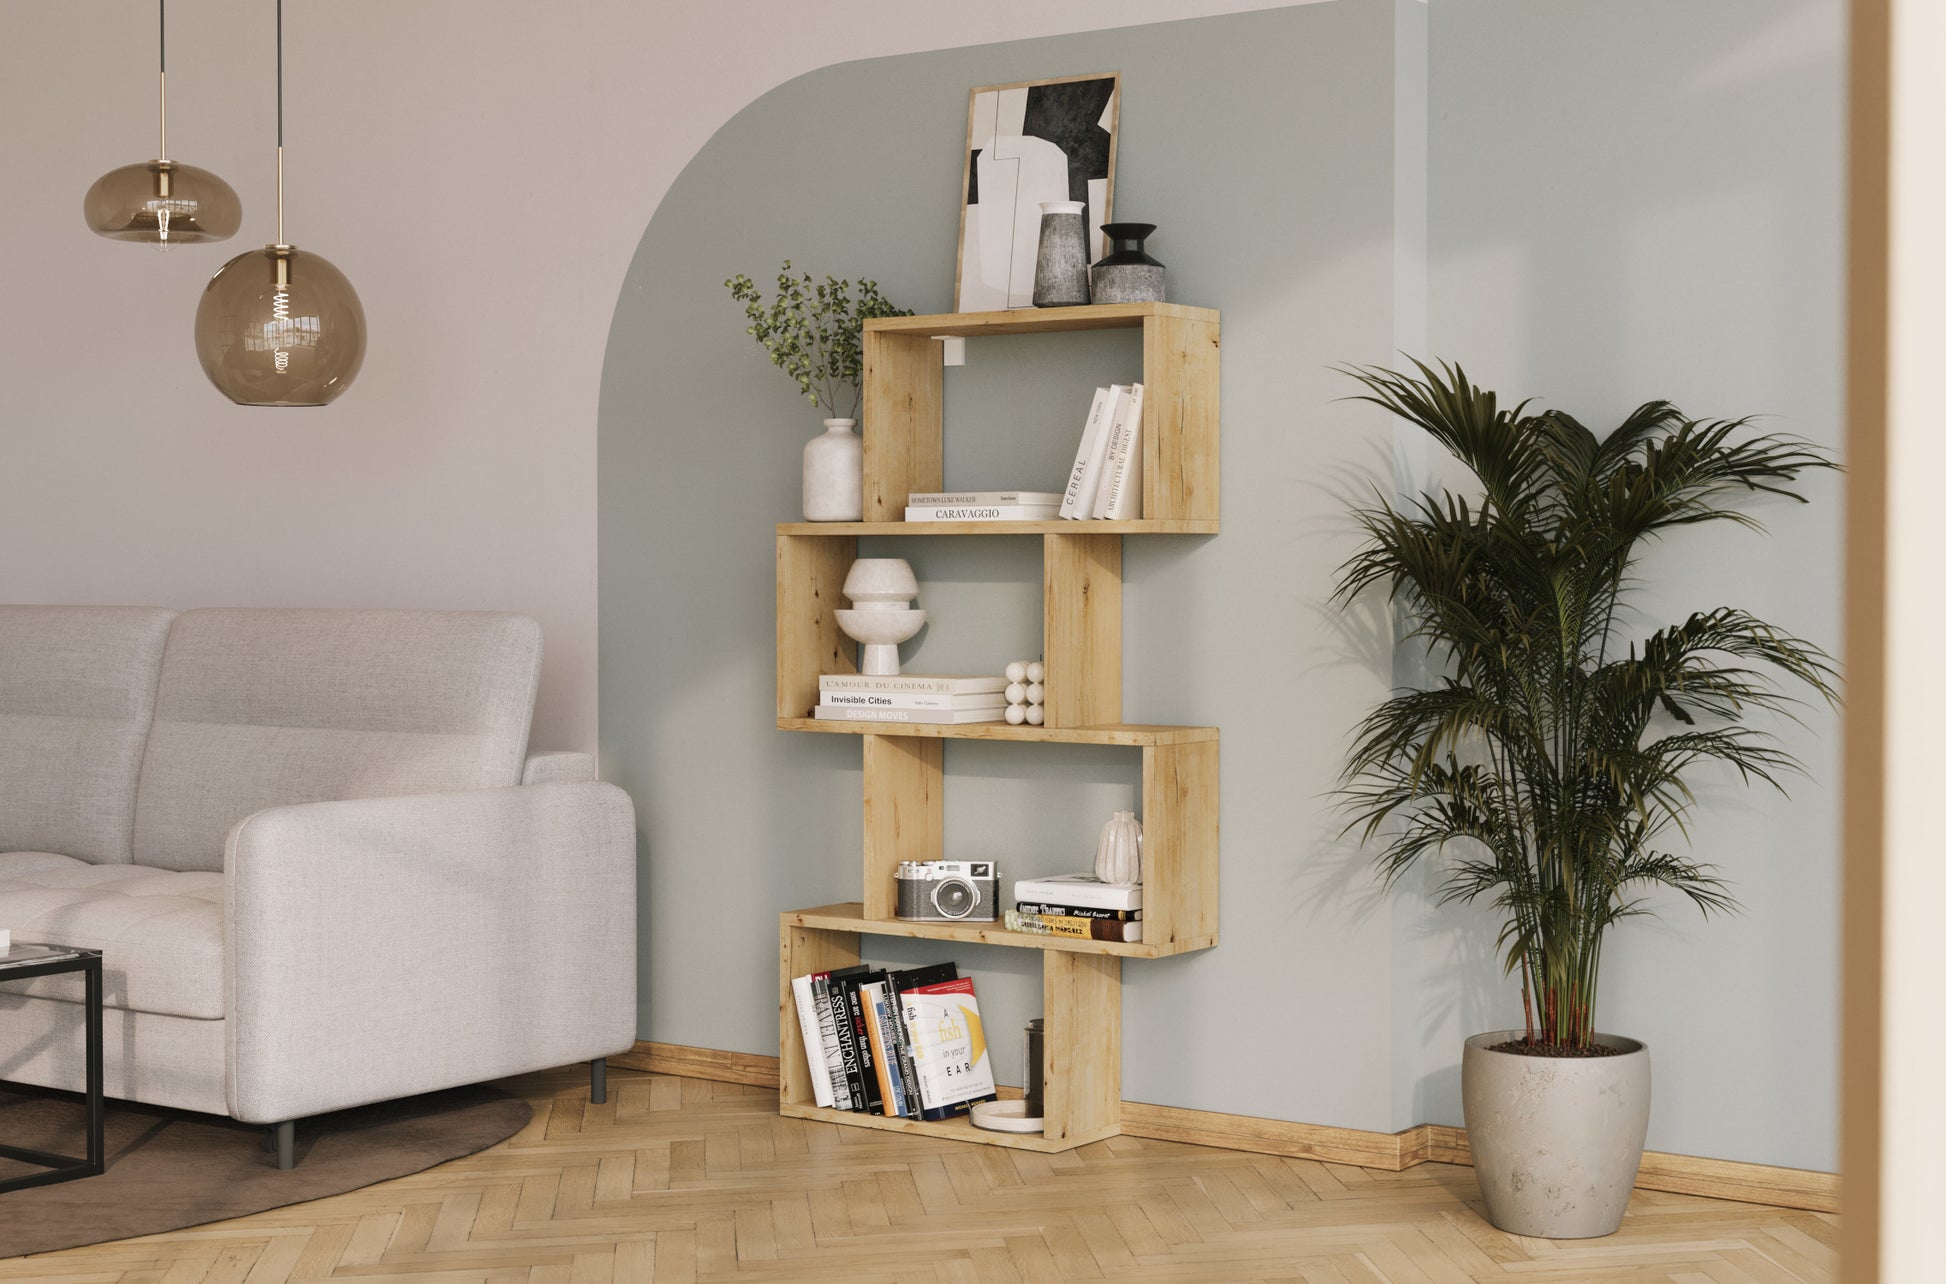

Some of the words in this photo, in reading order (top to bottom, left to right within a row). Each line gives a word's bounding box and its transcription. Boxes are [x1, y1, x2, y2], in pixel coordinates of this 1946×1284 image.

[1111, 424, 1122, 451] DESIGN
[1109, 452, 1115, 460] BY
[1108, 456, 1126, 511] ARCHITECTURAL
[1120, 430, 1132, 455] DIGEST
[1066, 460, 1086, 506] CEREAL
[936, 508, 1000, 518] CARAVAGGIO
[826, 680, 870, 689] L'AMOUR
[831, 696, 866, 704] Invisible
[868, 696, 892, 706] Cities
[846, 710, 878, 720] DESIGN
[878, 711, 908, 720] MOVES
[907, 1007, 916, 1020] fish
[944, 1008, 950, 1018] A
[831, 995, 858, 1074] ENCHANTRESS
[938, 1018, 962, 1042] fish
[859, 1036, 868, 1050] than
[862, 1050, 871, 1068] others
[943, 1048, 950, 1058] in
[951, 1047, 966, 1060] your
[946, 1062, 971, 1076] EAR
